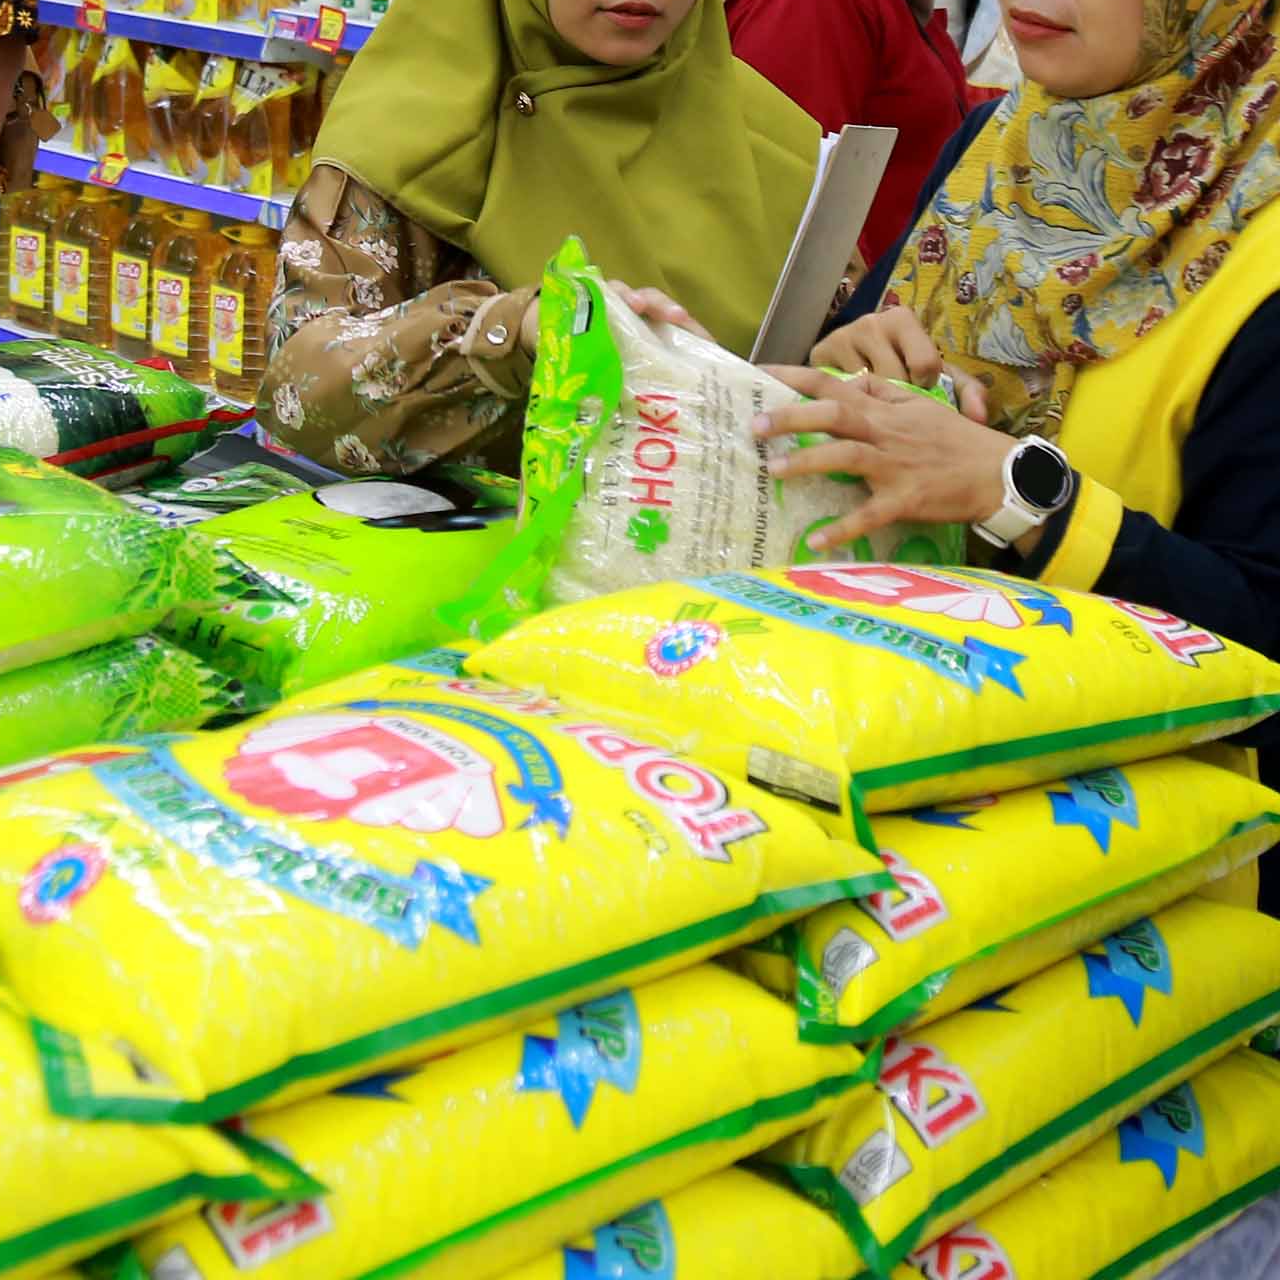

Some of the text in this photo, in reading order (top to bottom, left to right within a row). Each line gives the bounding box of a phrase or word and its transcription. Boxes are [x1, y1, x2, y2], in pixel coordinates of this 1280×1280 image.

[629, 392, 681, 510] HOKI
[755, 466, 768, 505] CARA
[751, 507, 768, 571] TUNJUK
[708, 574, 968, 675] BERAS SUPER
[579, 721, 769, 862] TOPI
